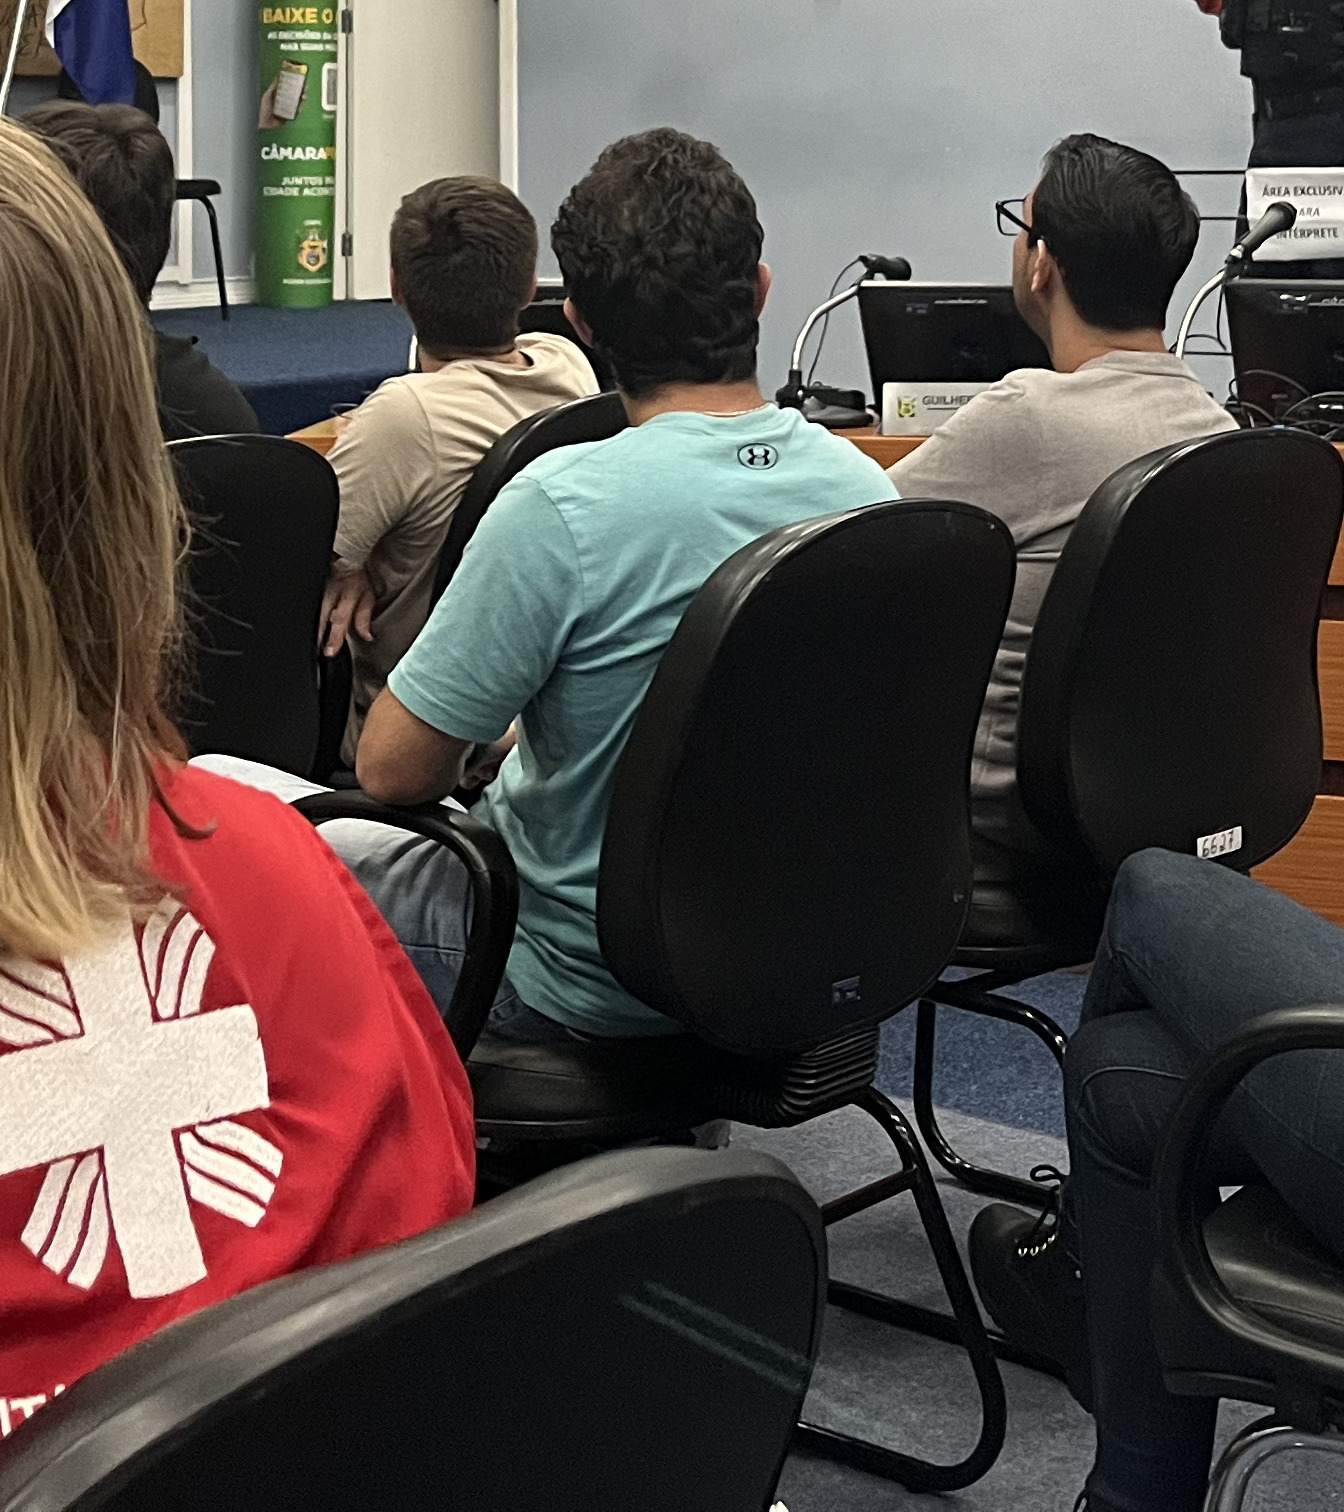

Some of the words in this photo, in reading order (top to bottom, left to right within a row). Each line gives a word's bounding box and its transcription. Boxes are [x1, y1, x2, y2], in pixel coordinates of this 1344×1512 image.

[263, 7, 318, 24] BAIXE
[1262, 184, 1290, 197] ÁREA
[1299, 207, 1320, 217] ARA
